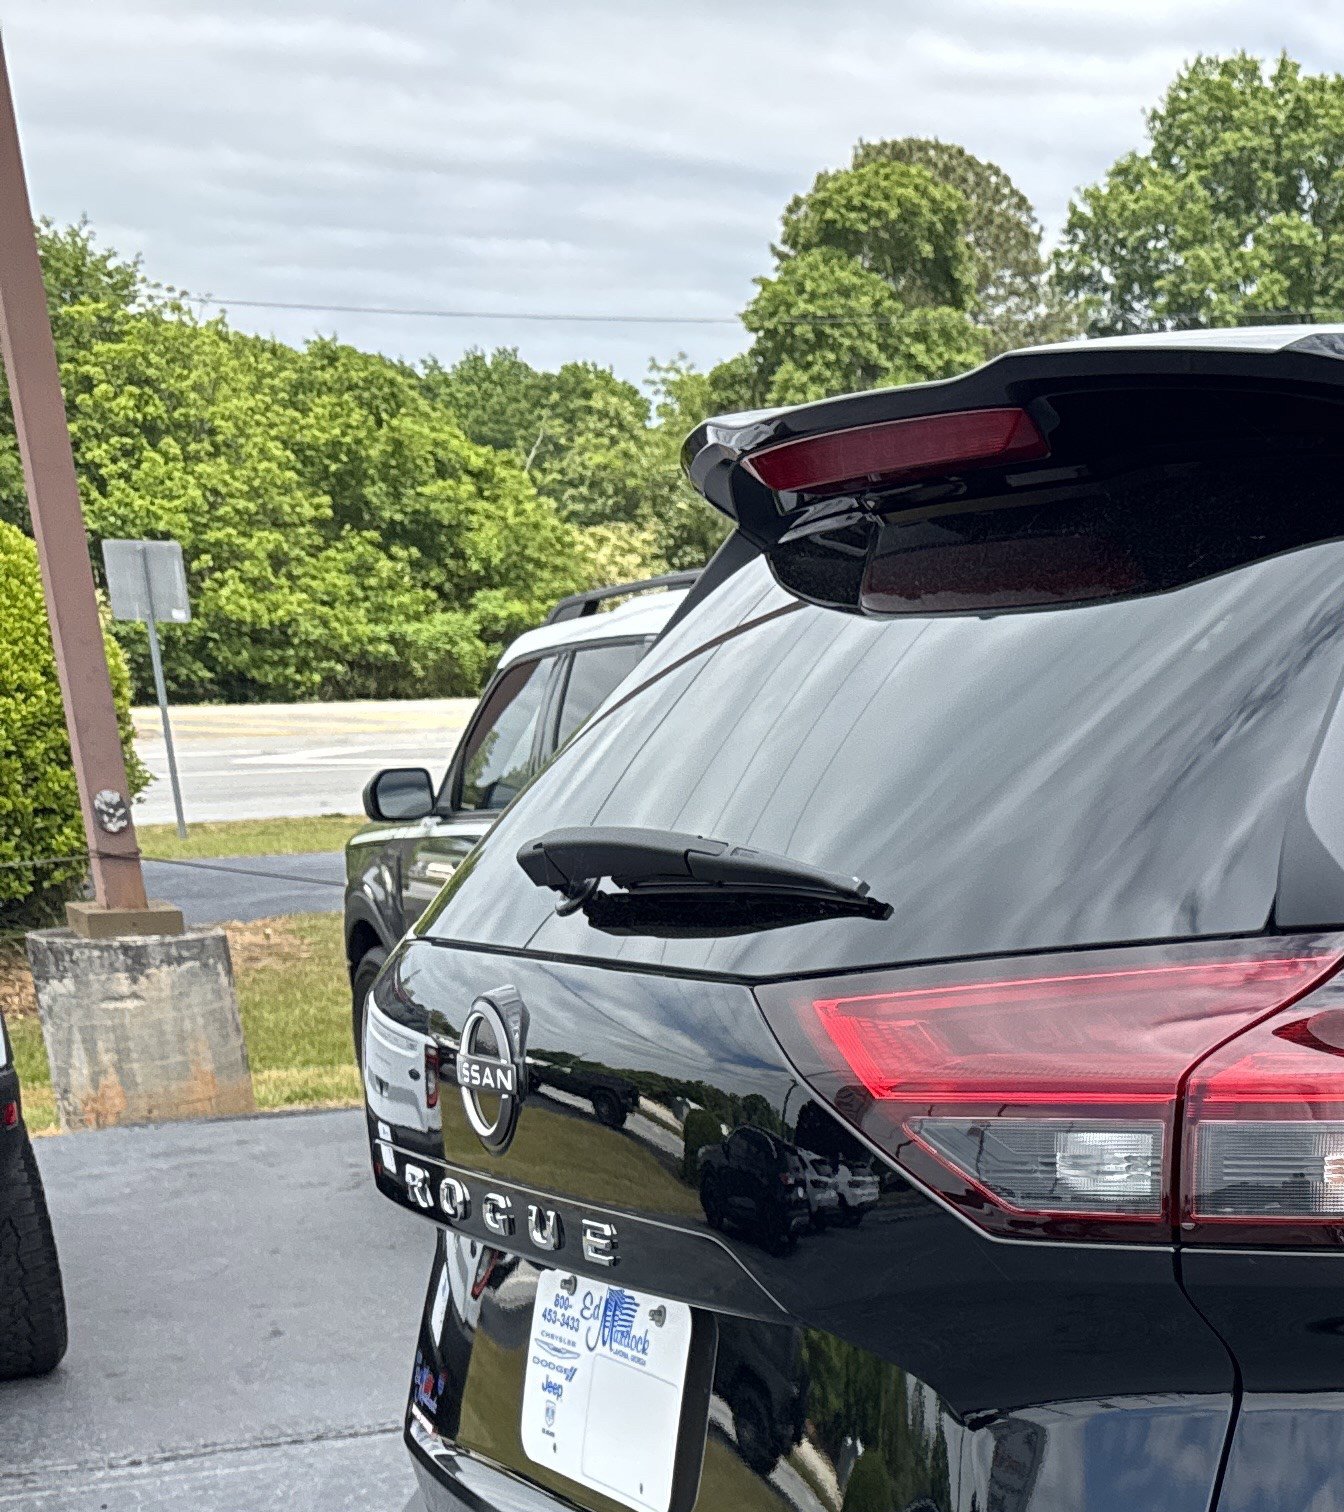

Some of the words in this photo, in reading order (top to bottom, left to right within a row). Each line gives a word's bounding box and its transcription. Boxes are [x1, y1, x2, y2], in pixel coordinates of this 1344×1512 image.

[462, 1062, 513, 1091] SSAN
[405, 1163, 621, 1267] ROGUE
[580, 1290, 603, 1320] Ed
[541, 1374, 563, 1400] Jeep
